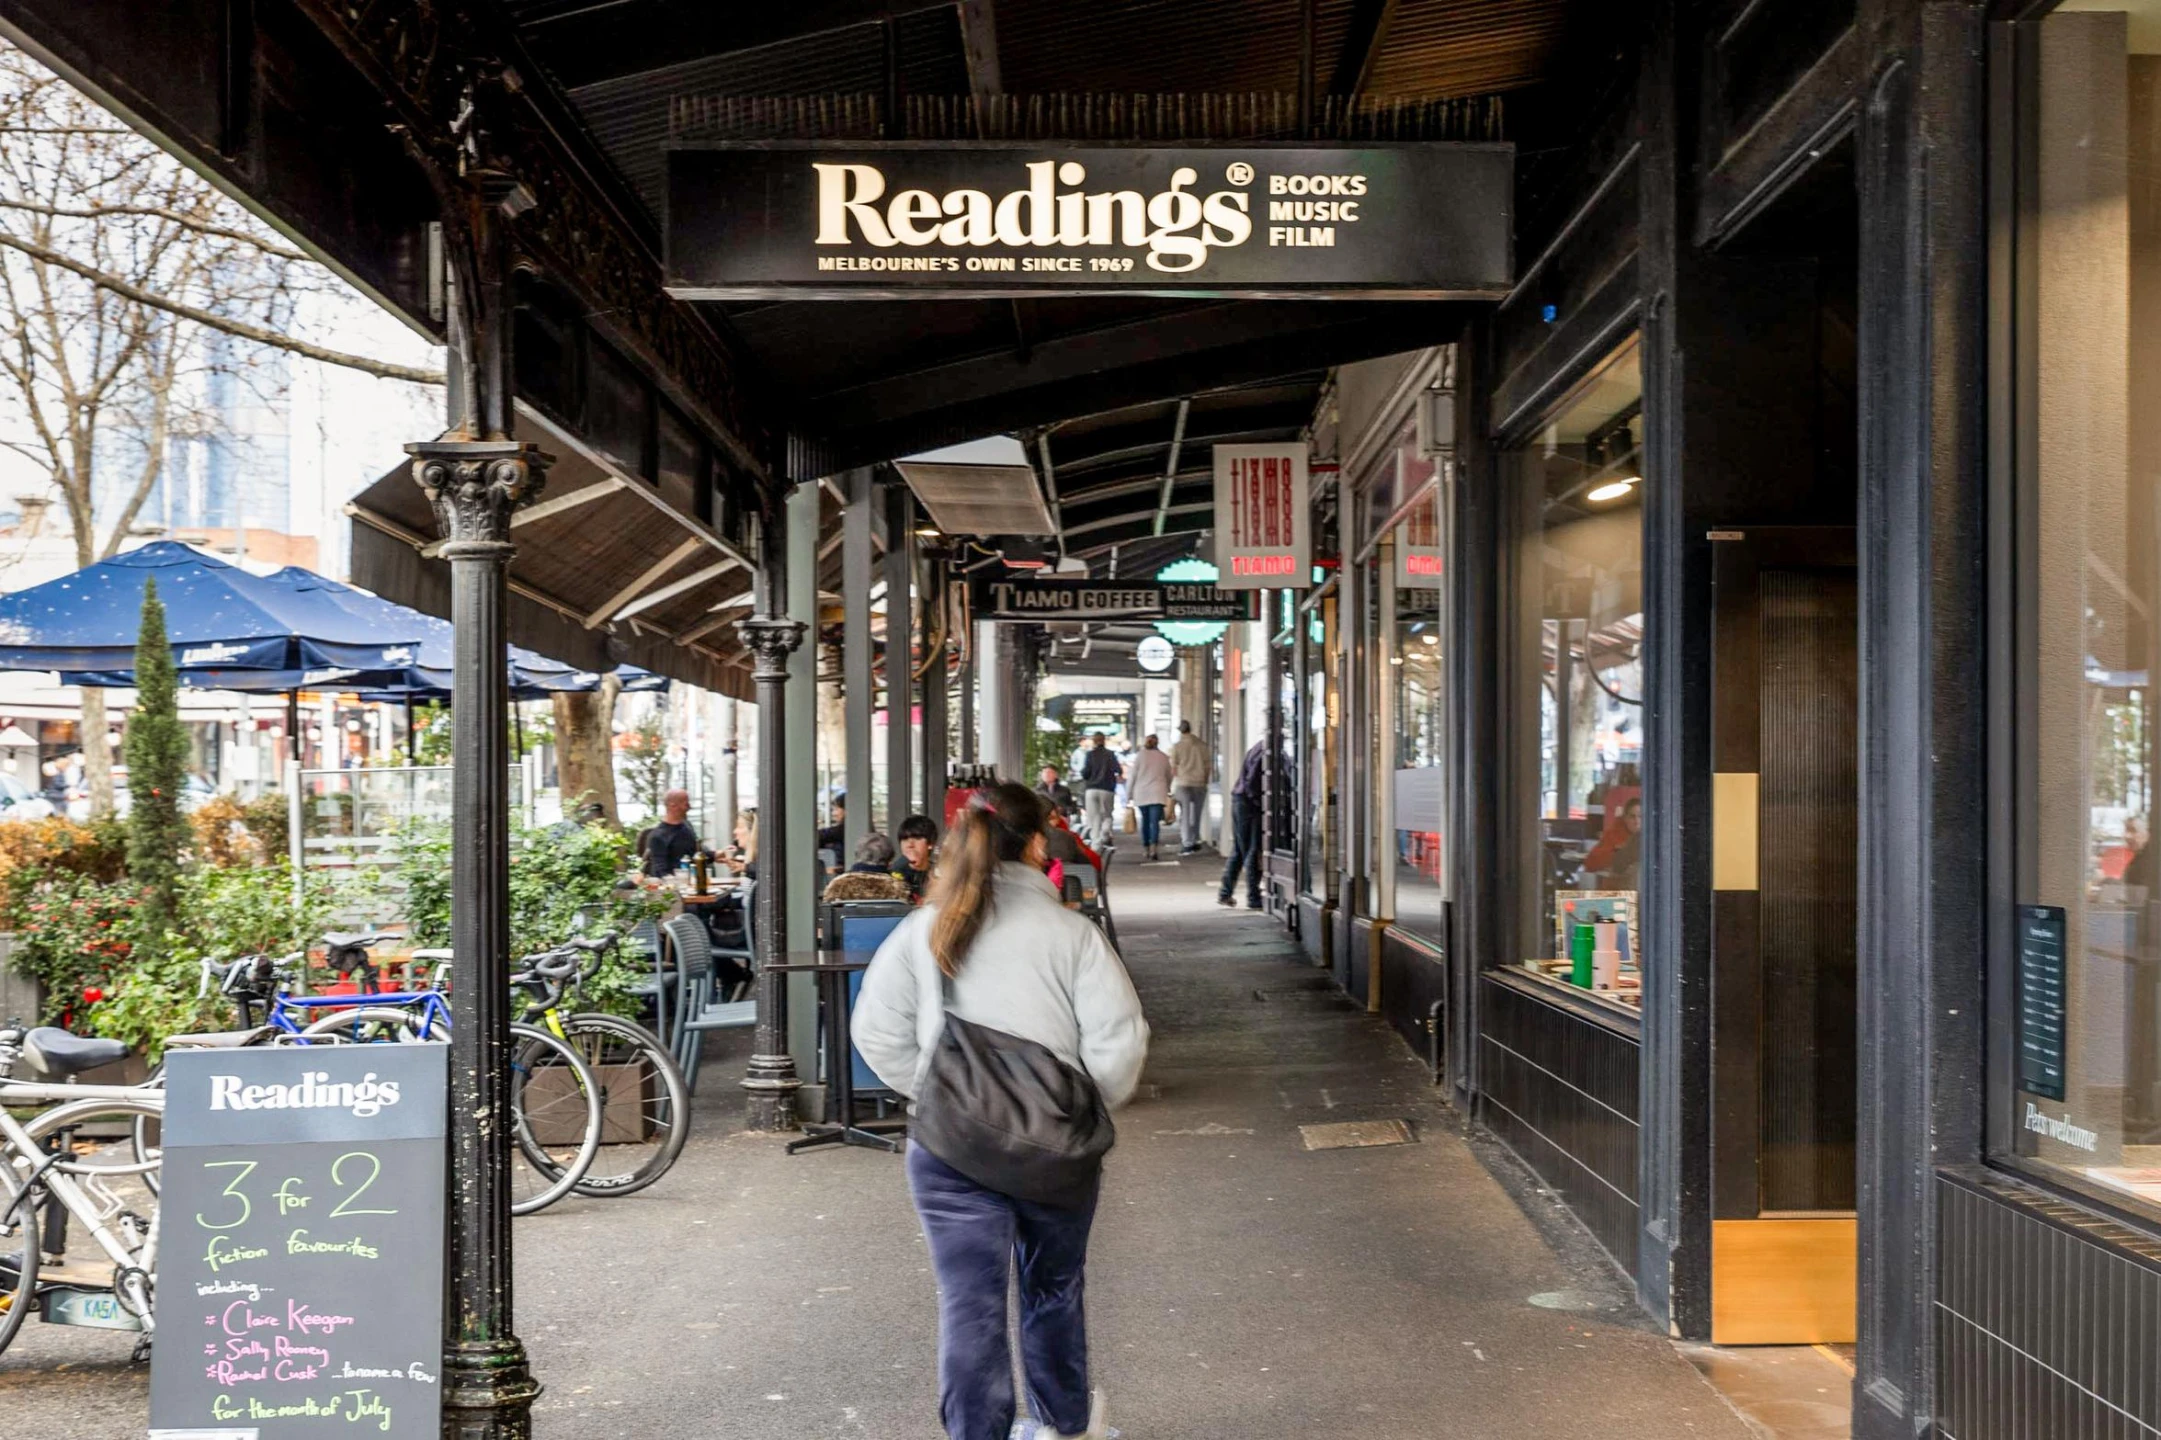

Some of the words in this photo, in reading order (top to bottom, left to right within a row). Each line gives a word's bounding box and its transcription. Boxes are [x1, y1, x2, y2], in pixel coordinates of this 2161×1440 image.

[1269, 174, 1367, 196] BOOKS
[1269, 201, 1360, 222] MUSIC
[1269, 226, 1336, 247] FILM
[818, 257, 960, 272] MELBOURNE'S
[965, 257, 1016, 272] OWN
[1021, 257, 1083, 272] SINCE
[1088, 257, 1135, 273] 1969
[1230, 555, 1296, 575] TIAMO
[989, 582, 1072, 613] TIAMO
[1083, 591, 1155, 609] COFFEE
[209, 1071, 401, 1117] Readings
[196, 1160, 259, 1229] 3
[272, 1177, 312, 1216] for
[329, 1152, 399, 1218] 2
[203, 1235, 269, 1272] fiction
[286, 1228, 379, 1259] favourites
[222, 1300, 281, 1336] Claire
[288, 1298, 355, 1335] Keegan
[226, 1338, 270, 1362] Sally
[275, 1335, 330, 1368] Rooney
[274, 1359, 318, 1381] Cusk
[211, 1394, 245, 1421] for
[249, 1397, 277, 1419] the
[320, 1396, 342, 1417] of
[344, 1389, 393, 1431] July
